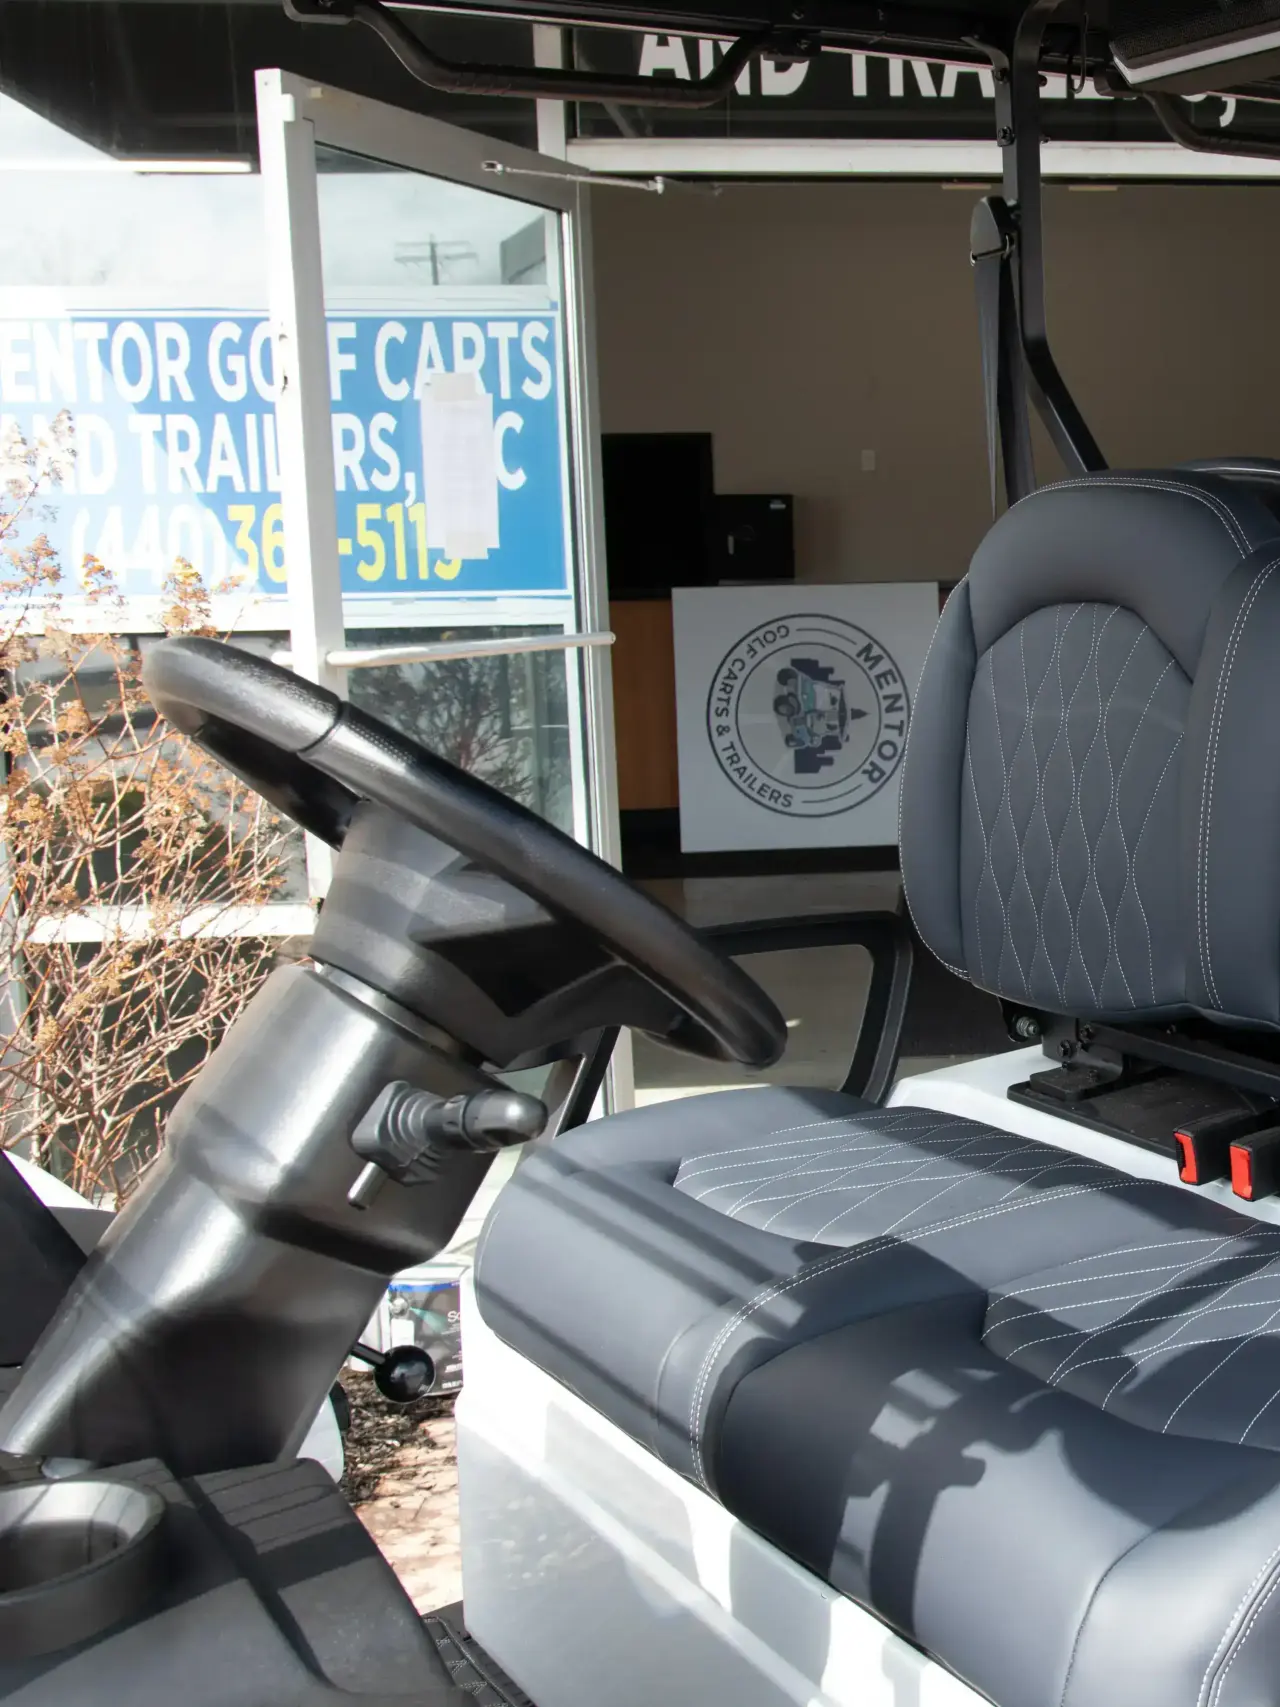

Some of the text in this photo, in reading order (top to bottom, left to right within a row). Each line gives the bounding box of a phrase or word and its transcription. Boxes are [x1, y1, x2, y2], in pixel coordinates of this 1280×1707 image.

[208, 321, 357, 402] GOF
[374, 320, 552, 401] CARTS
[128, 411, 416, 508] TRAILRS,
[714, 624, 794, 808] GOLF CARTS & TRAILERS
[856, 642, 905, 784] MENTOR
